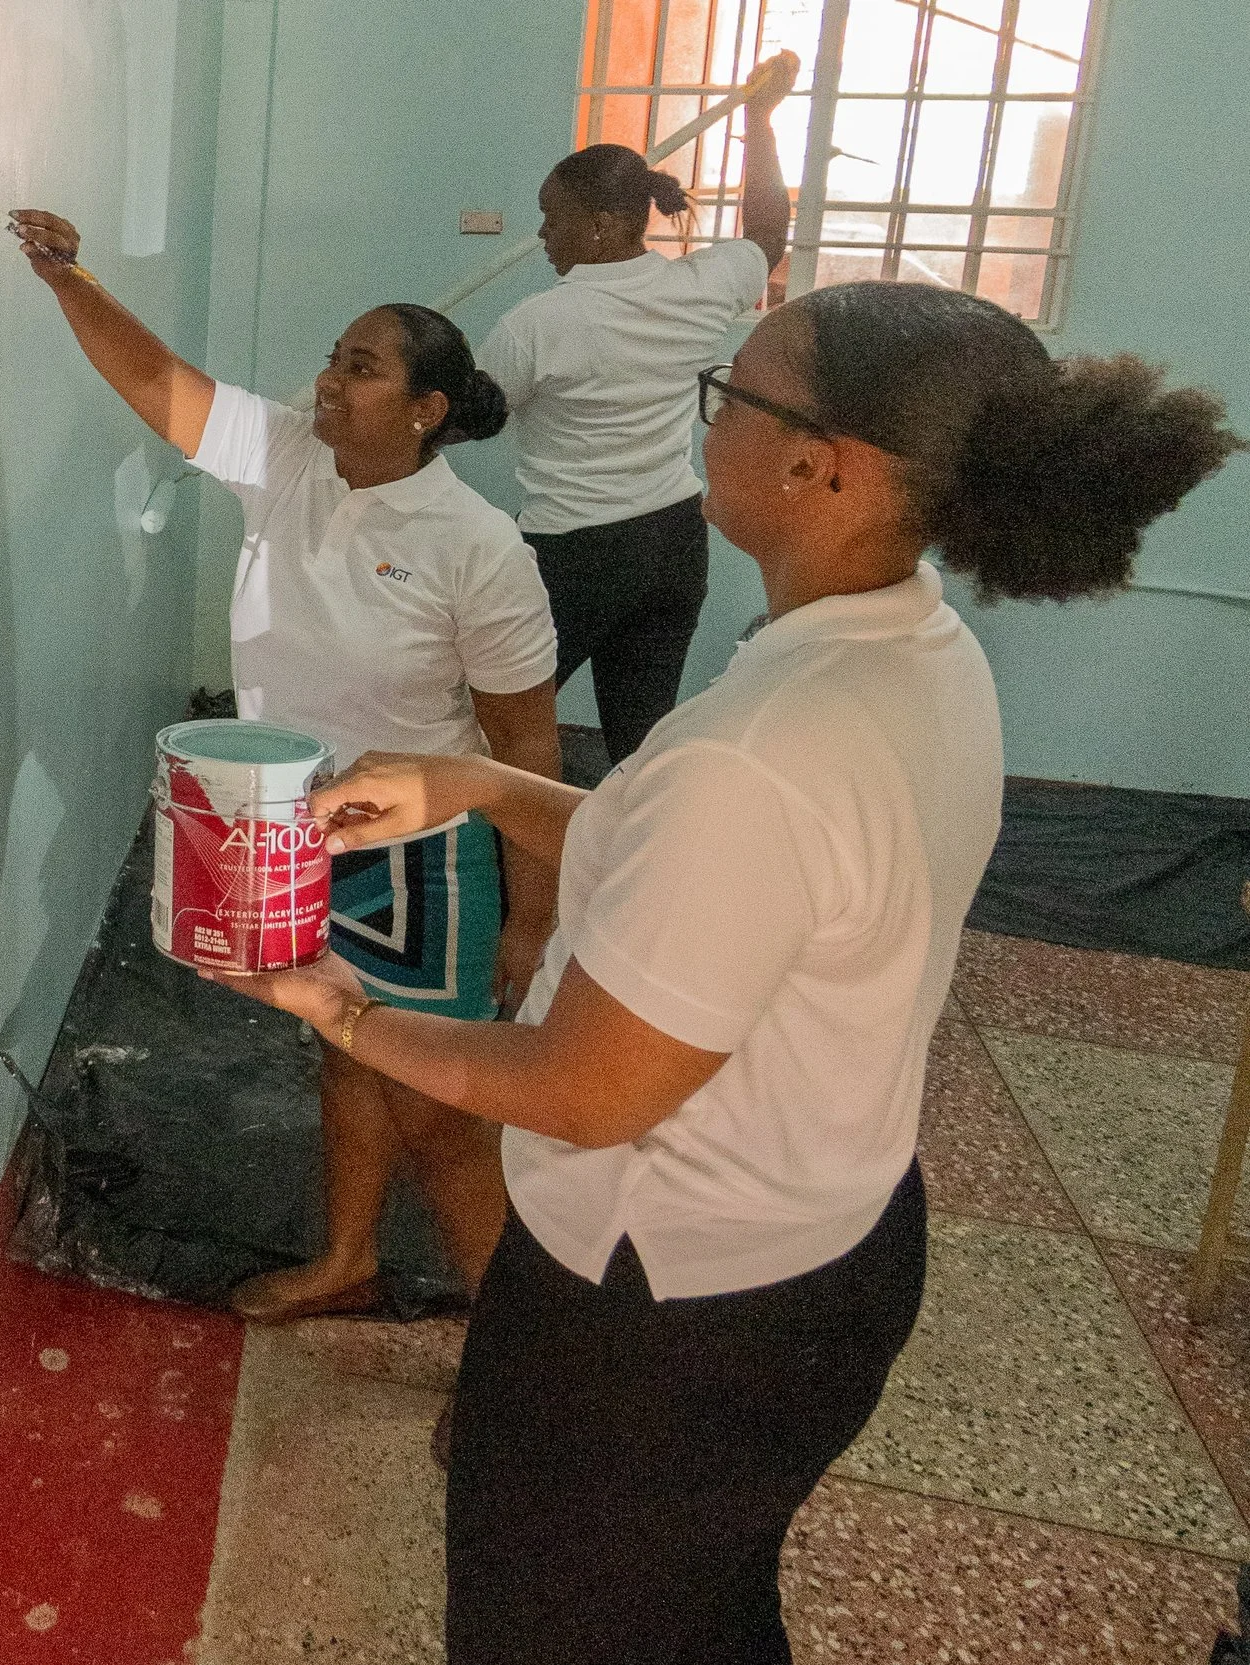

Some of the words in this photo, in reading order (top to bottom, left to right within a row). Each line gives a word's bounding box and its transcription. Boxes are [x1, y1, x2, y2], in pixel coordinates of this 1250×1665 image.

[389, 567, 413, 583] IGT
[219, 823, 324, 854] A-100
[269, 907, 305, 919] ACRYIC
[305, 900, 324, 913] LATEX
